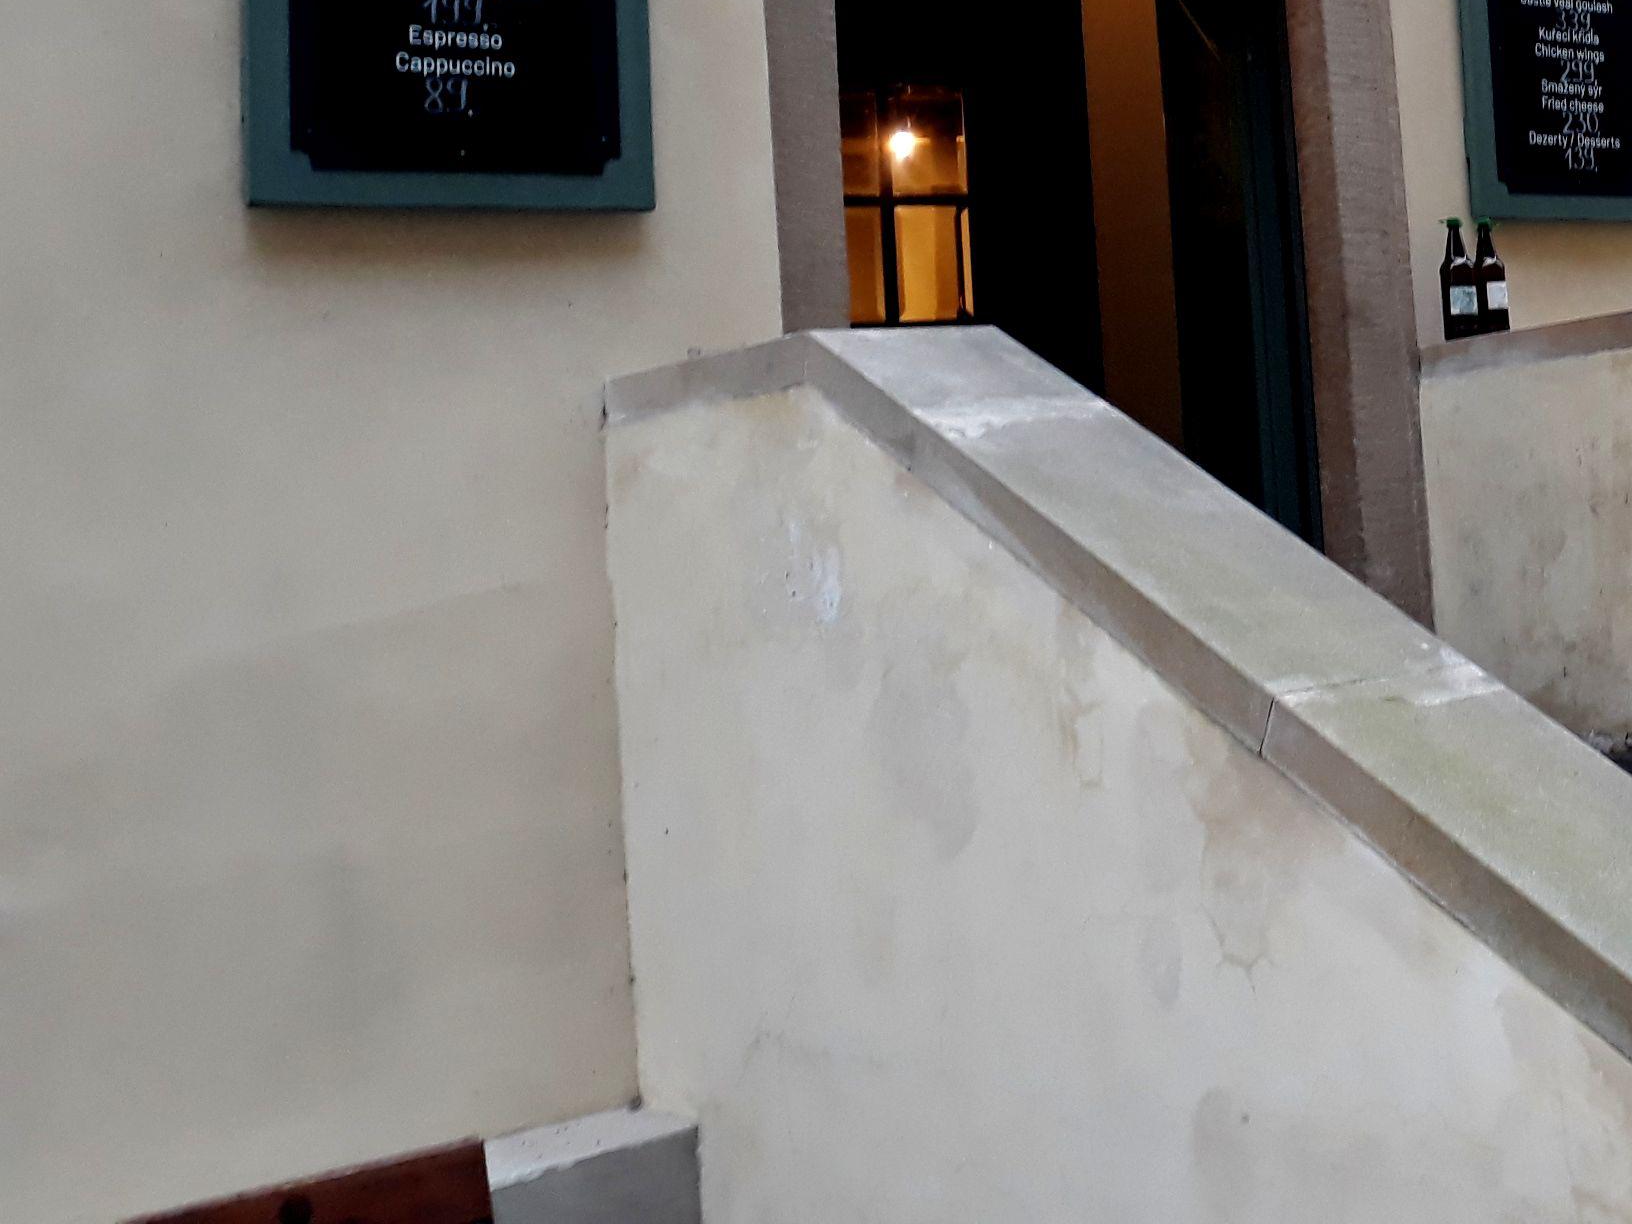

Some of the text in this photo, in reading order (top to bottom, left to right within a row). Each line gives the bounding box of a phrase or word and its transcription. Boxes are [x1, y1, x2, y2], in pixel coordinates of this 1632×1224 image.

[1576, 0, 1613, 15] goulash
[409, 25, 502, 50] Espresso
[1535, 43, 1605, 64] Chicken wings
[396, 52, 515, 77] Cappuccino
[1541, 78, 1585, 98] Smažený
[1542, 95, 1605, 113] Fried cheese
[1529, 130, 1568, 149] Dezerty
[1577, 133, 1621, 149] Desserts
